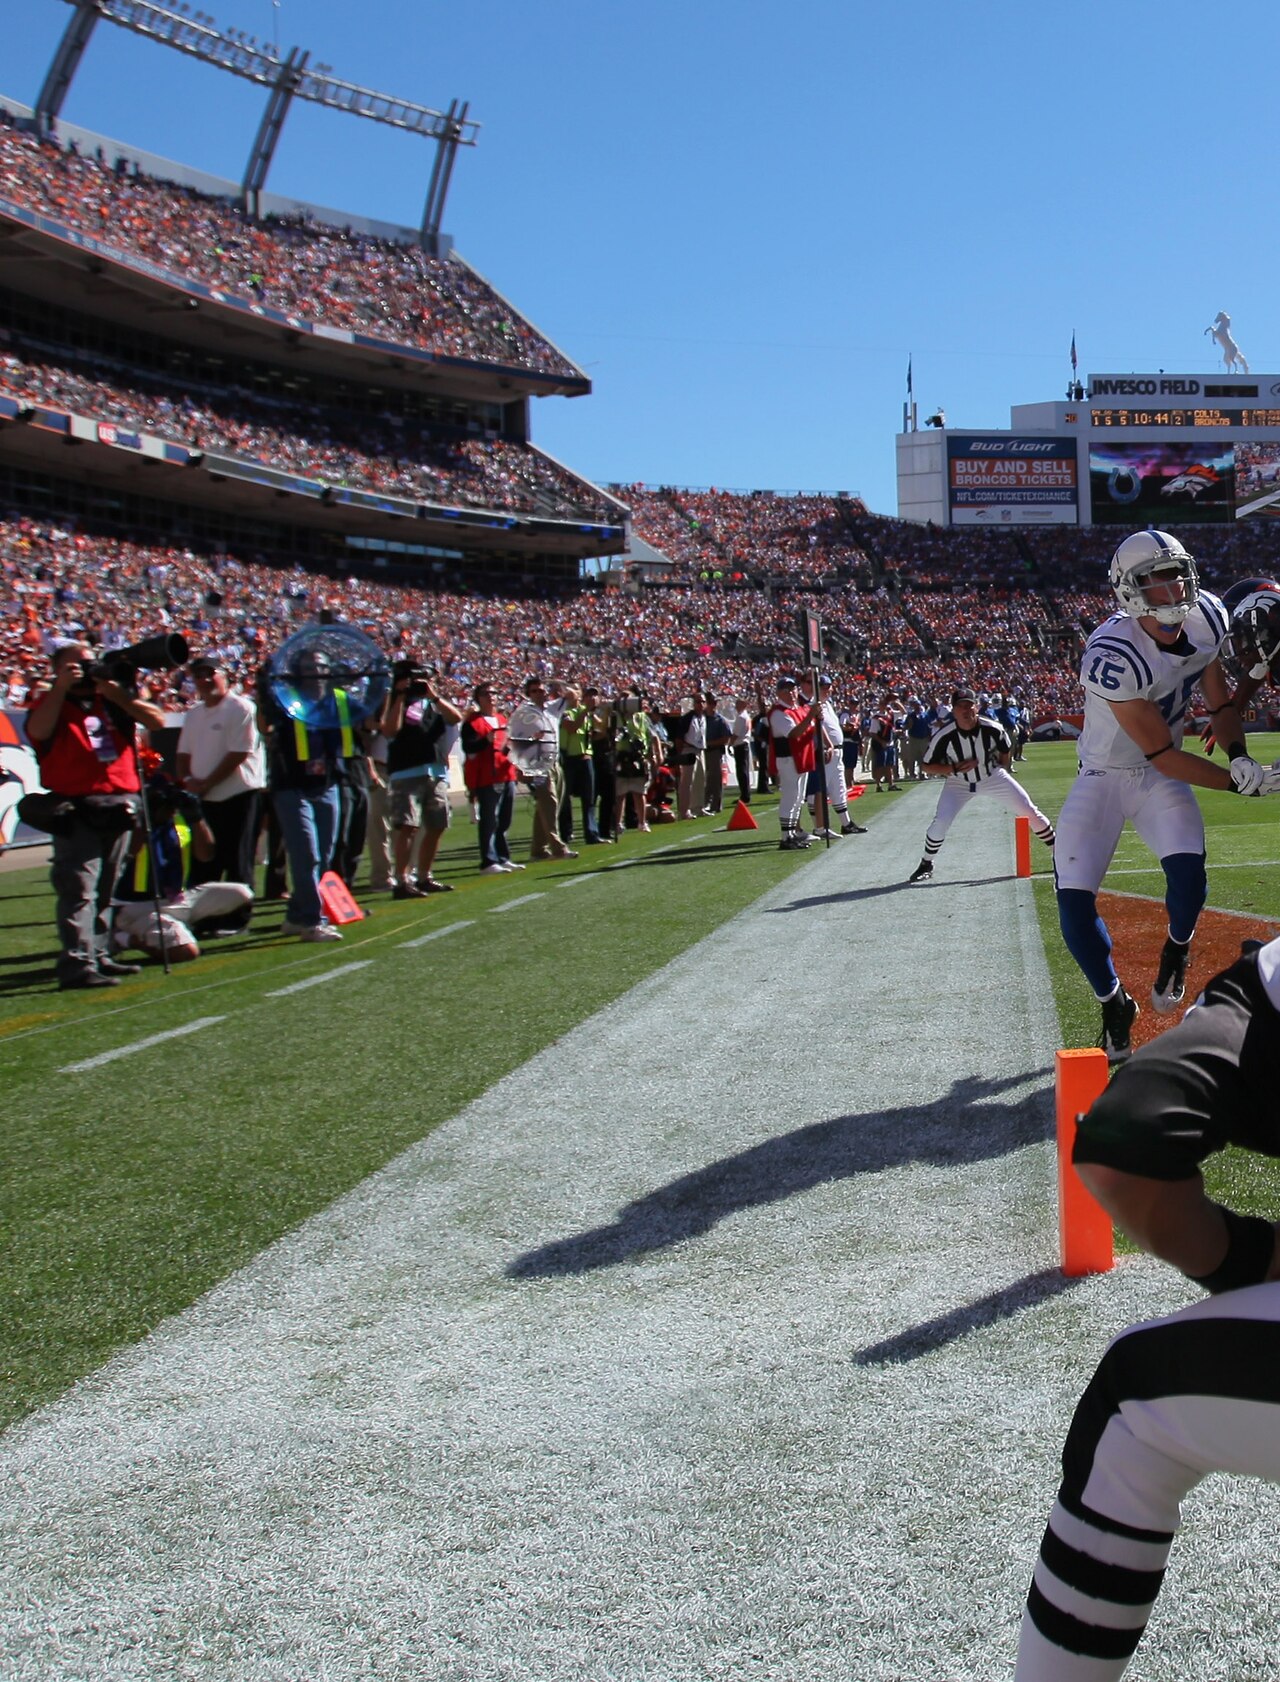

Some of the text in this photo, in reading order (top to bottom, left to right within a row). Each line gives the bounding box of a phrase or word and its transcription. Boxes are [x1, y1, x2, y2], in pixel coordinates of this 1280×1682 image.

[1092, 380, 1200, 395] INVESCO FIELD
[1134, 412, 1169, 425] 10:44
[1194, 410, 1220, 418] COLTS
[1174, 416, 1181, 425] 2
[1194, 418, 1231, 426] BRONCOS
[969, 441, 1056, 452] BUD LIGHT
[956, 461, 1072, 473] BUY AND SELL
[956, 474, 1072, 485] BRONCOS TICKETS
[957, 491, 1072, 501] NFL.COM/TICKETEXCHANGE
[1087, 656, 1126, 691] 15
